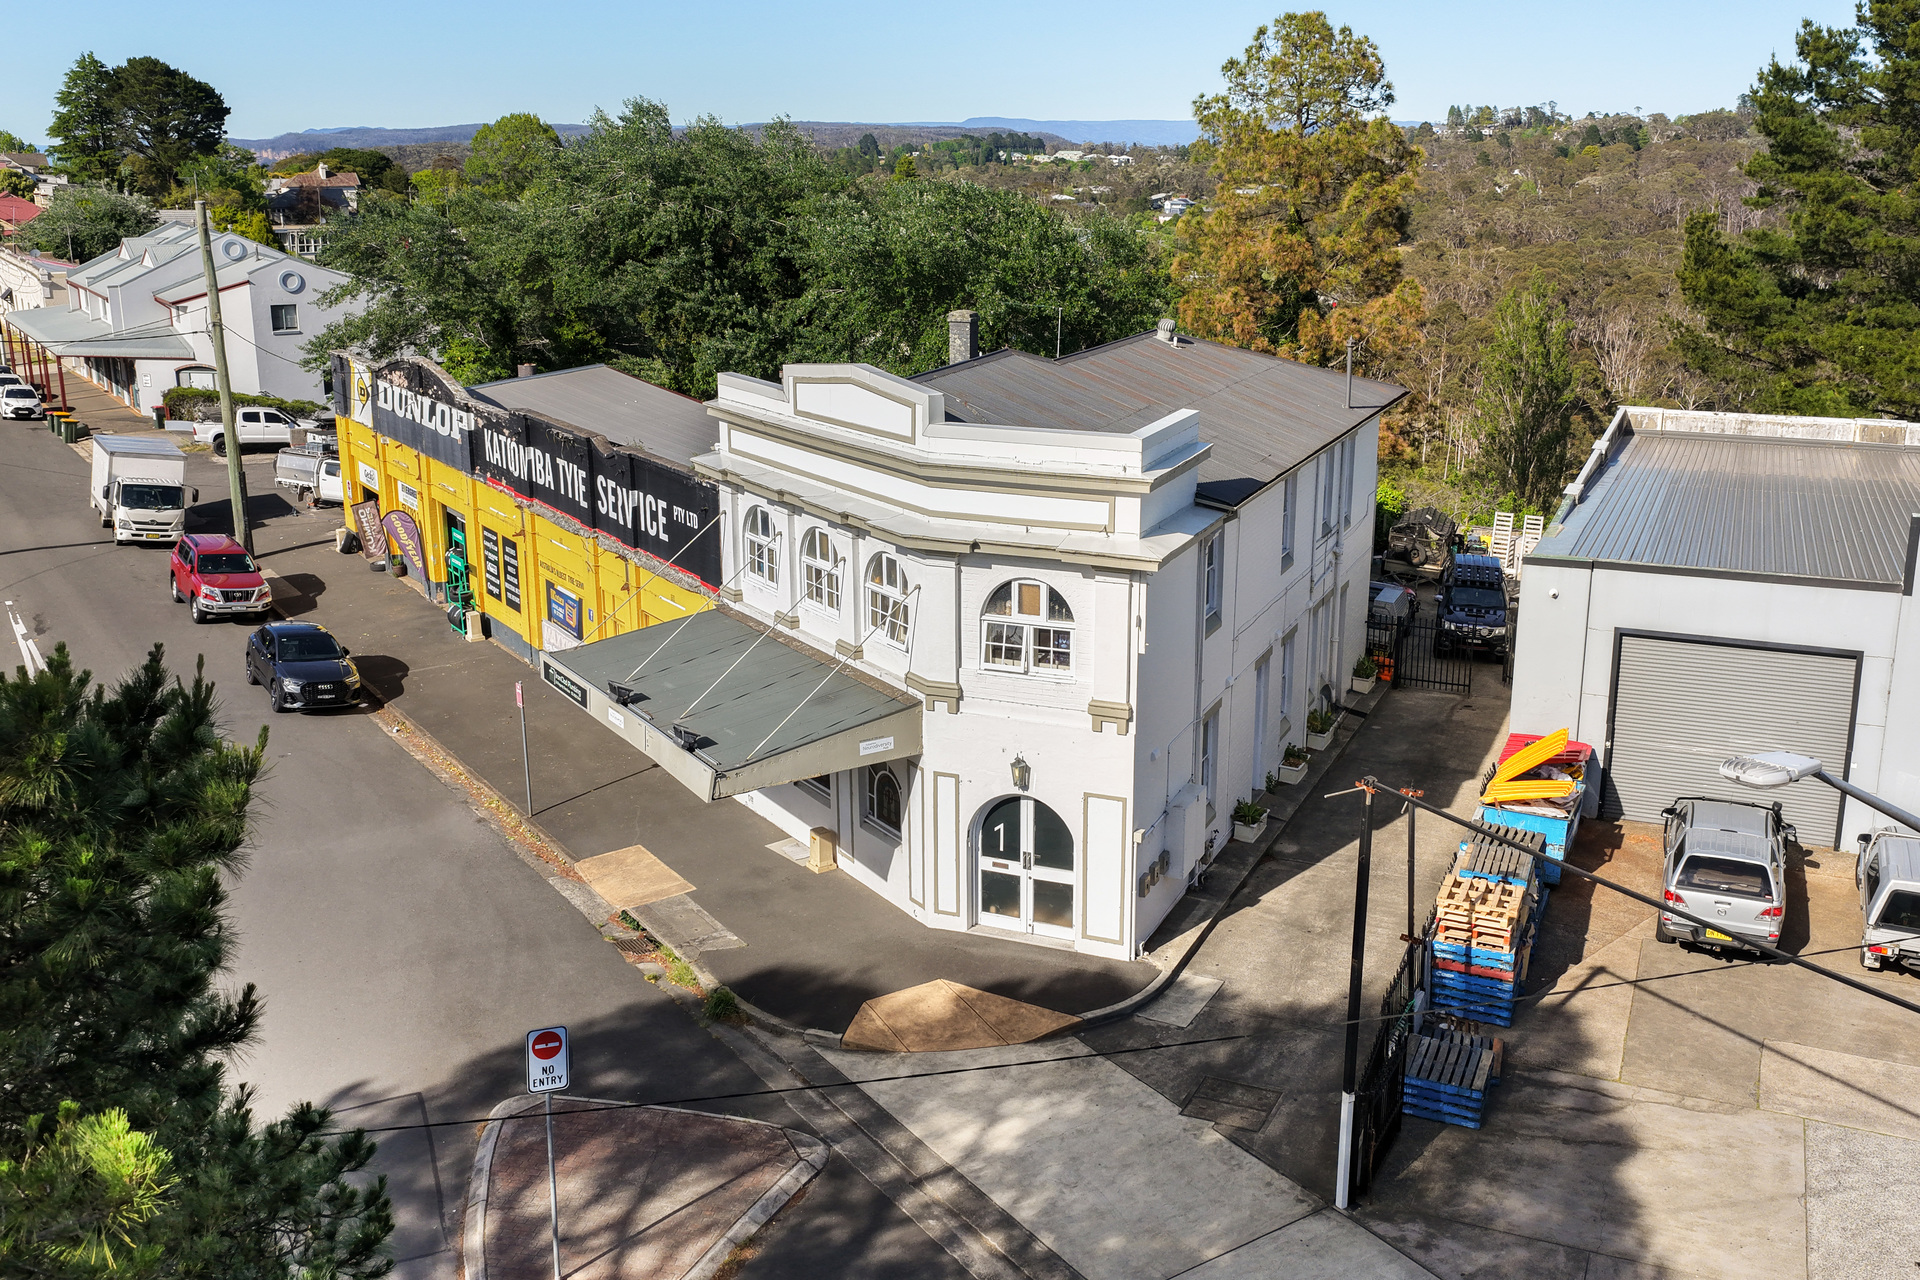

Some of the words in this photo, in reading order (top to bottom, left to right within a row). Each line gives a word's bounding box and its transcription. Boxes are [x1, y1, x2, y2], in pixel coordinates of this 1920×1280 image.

[377, 379, 475, 440] DUNLOP
[358, 508, 376, 553] KUMHO
[673, 504, 685, 524] PTY
[686, 510, 699, 530] LTD
[390, 513, 422, 570] GOODYEAR
[994, 822, 1004, 852] 1
[532, 1074, 564, 1088] ENTRY
[541, 1064, 555, 1076] NO
